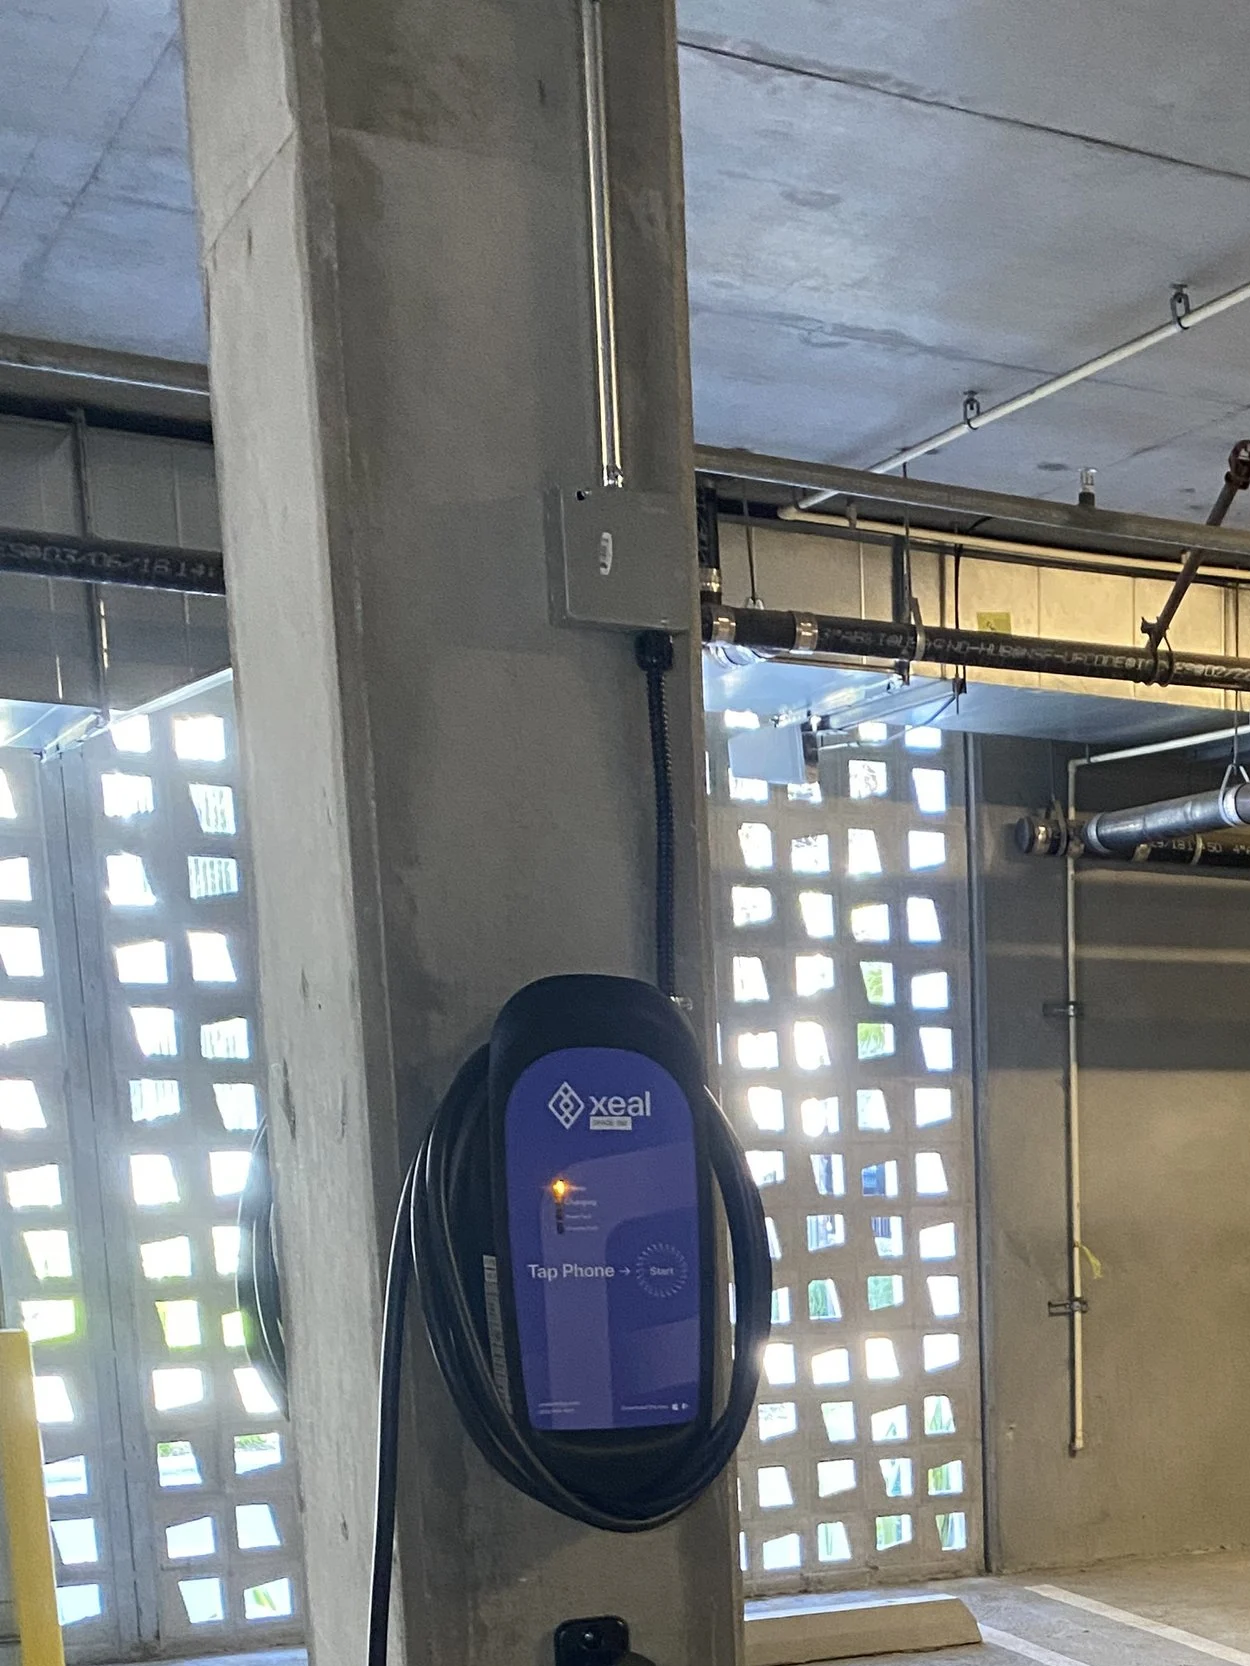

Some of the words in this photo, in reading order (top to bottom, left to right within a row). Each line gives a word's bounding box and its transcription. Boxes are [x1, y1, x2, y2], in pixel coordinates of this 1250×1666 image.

[589, 1091, 651, 1117] xeal
[528, 1264, 558, 1281] Tap
[562, 1264, 615, 1278] Phone
[650, 1266, 674, 1276] Start
